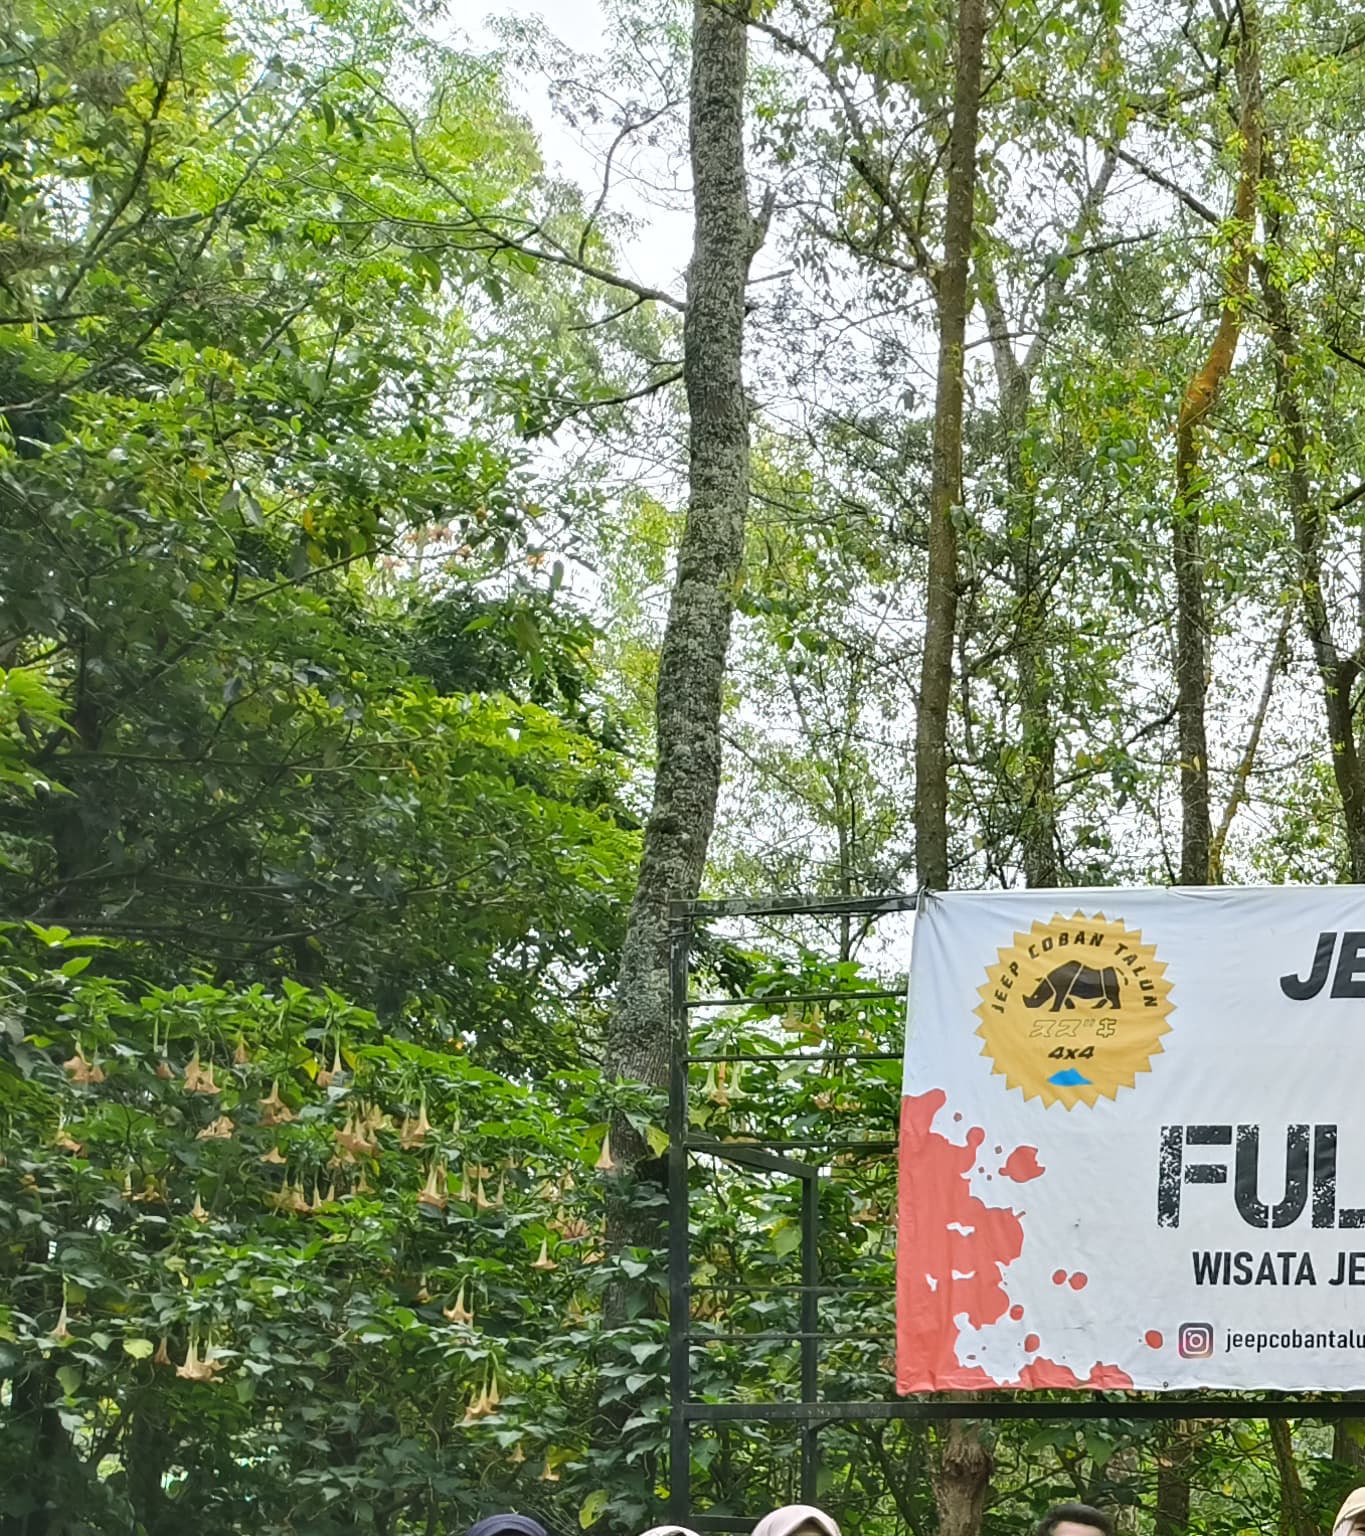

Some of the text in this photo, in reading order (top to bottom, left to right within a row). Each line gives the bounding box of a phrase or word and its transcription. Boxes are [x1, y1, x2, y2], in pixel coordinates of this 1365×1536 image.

[992, 931, 1158, 1014] JEEP COBAN TALUN
[1048, 1046, 1095, 1059] 4x4
[1192, 1251, 1317, 1286] WISATA
